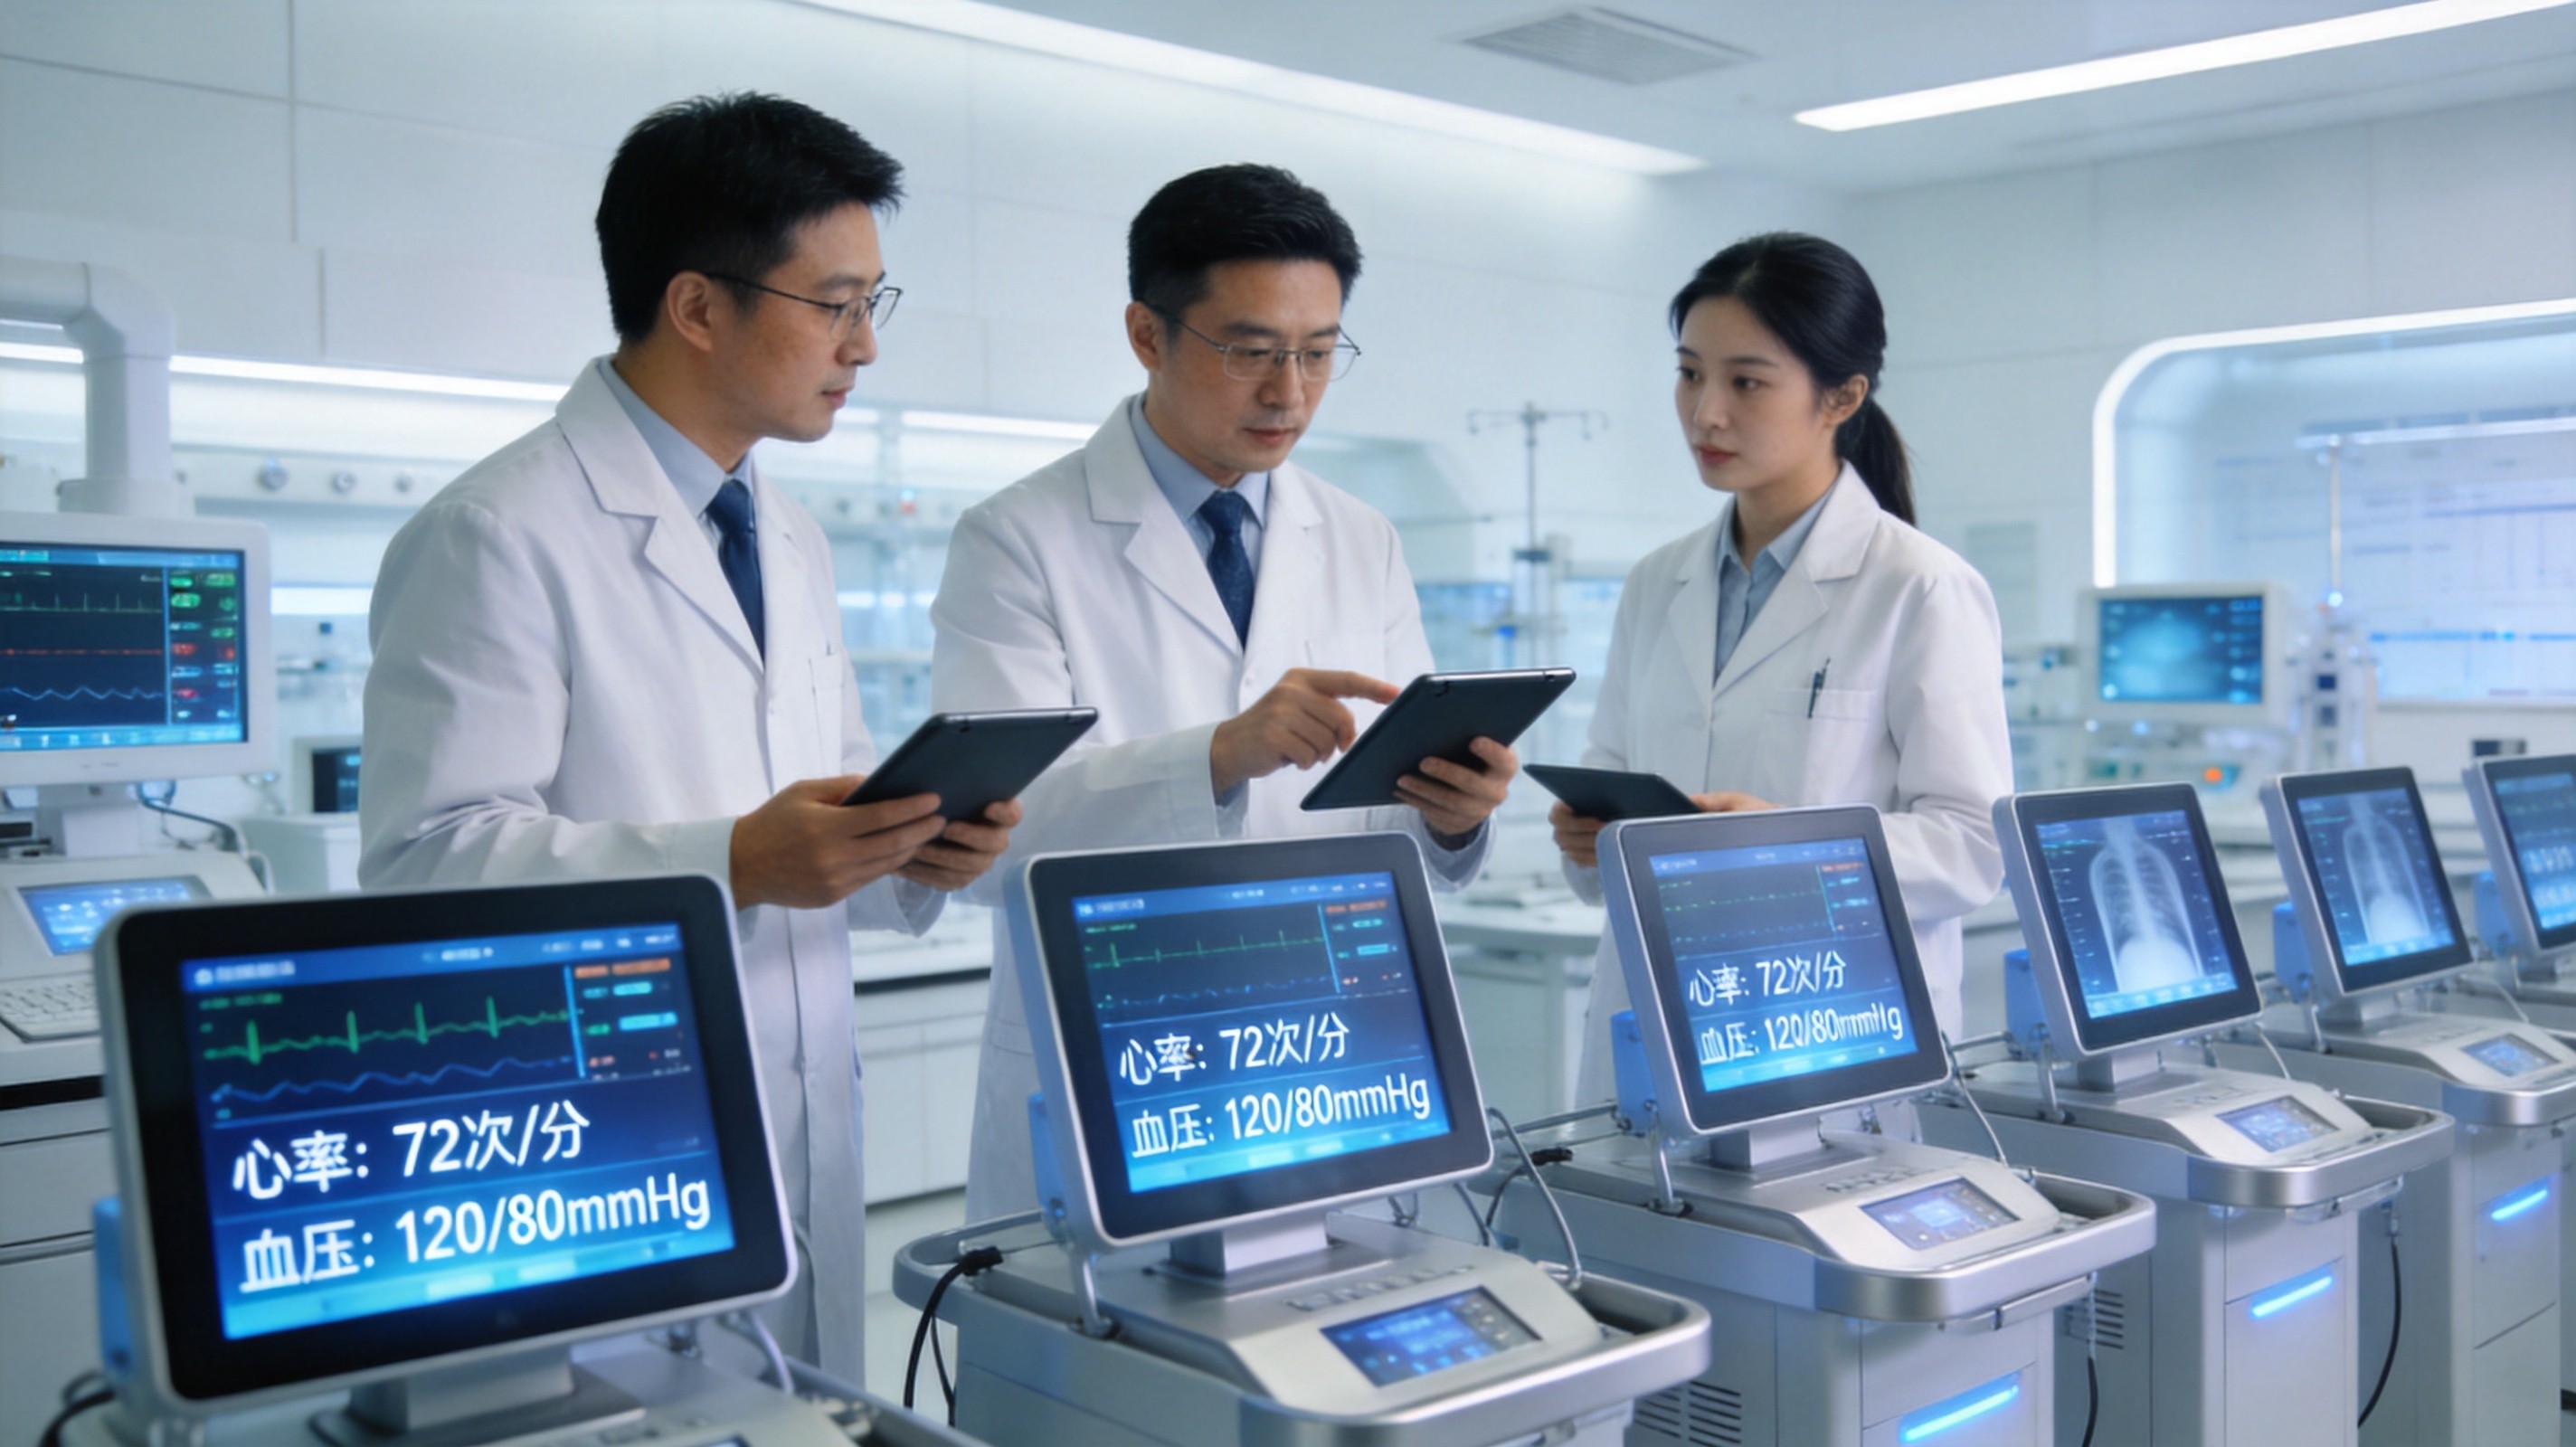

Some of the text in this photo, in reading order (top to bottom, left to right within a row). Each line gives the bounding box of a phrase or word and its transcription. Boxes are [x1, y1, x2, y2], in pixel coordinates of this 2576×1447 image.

[1756, 950, 1846, 997] 72次/分
[1218, 1012, 1350, 1071] 72次/分
[393, 1099, 591, 1177] 72次/分
[1225, 1073, 1429, 1141] 120/80mmHg
[395, 1172, 712, 1263] 120/80mmHg
